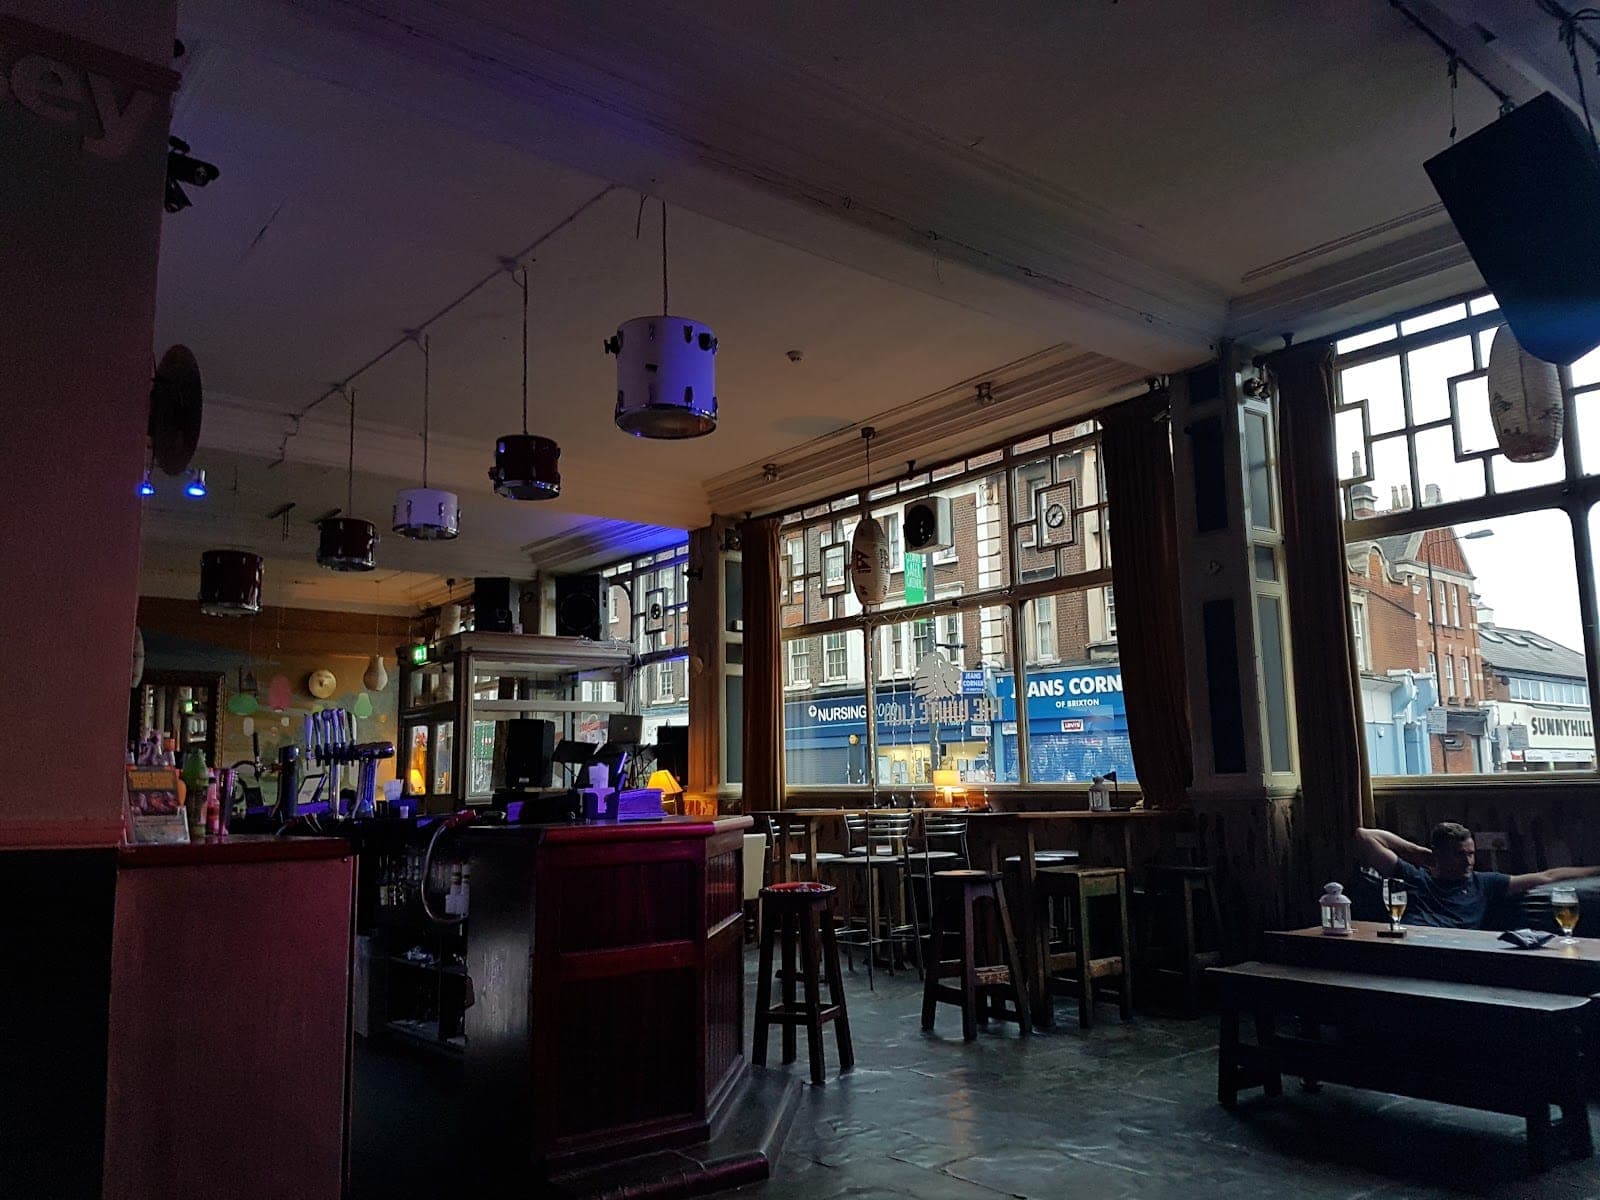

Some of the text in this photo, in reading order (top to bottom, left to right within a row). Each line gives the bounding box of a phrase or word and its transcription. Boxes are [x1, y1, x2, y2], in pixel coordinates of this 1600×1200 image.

[0, 54, 160, 157] ey
[1055, 698, 1099, 709] OF BRIXTON
[818, 704, 867, 722] NURSING
[1531, 717, 1592, 736] SUNNYHILL
